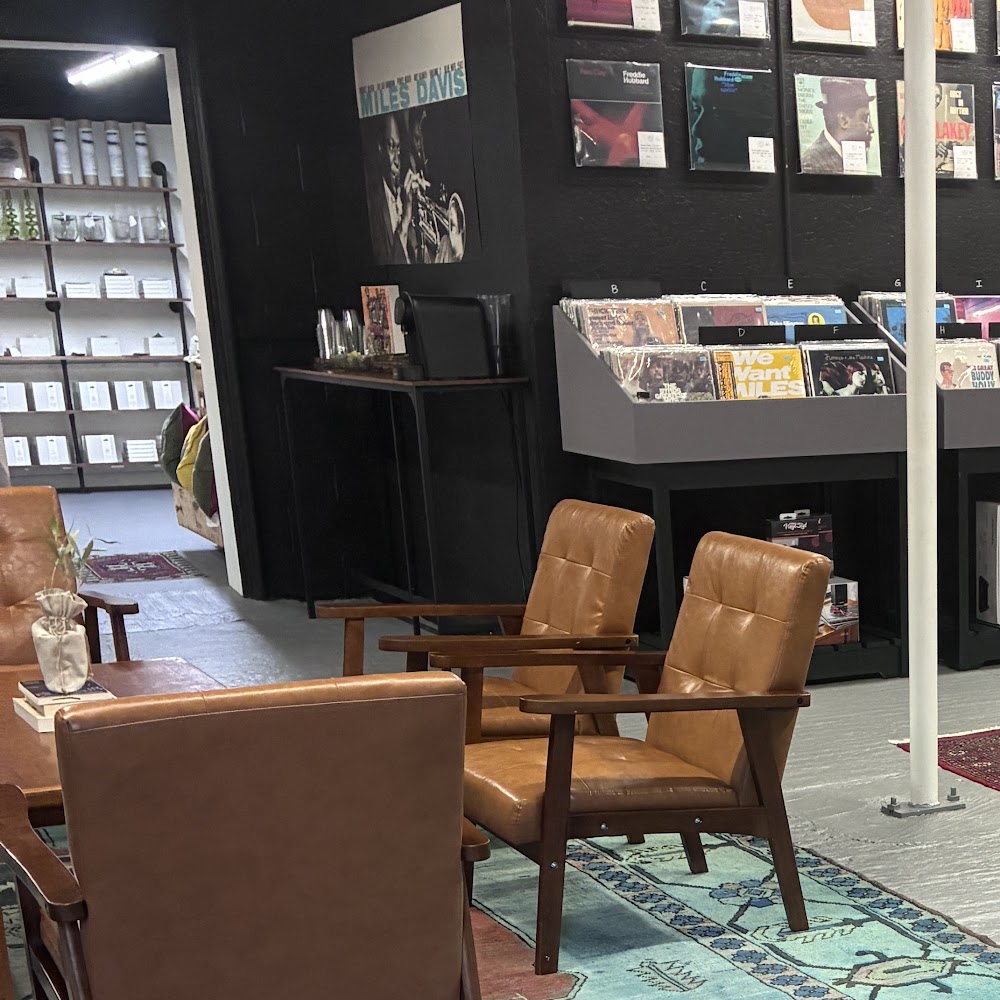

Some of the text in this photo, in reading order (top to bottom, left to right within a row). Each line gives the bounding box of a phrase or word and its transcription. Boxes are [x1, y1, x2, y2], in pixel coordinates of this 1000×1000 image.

[622, 70, 646, 79] Freddie
[360, 80, 410, 117] MILES
[417, 66, 466, 106] DAVIS
[935, 121, 972, 141] LAKEY
[700, 281, 707, 291] C
[787, 279, 794, 289] E
[894, 278, 902, 287] G
[975, 279, 983, 288] I
[611, 284, 619, 294] B
[737, 327, 746, 337] D
[832, 325, 840, 334] F
[939, 325, 946, 335] H
[733, 350, 775, 365] We
[970, 371, 994, 380] BUDDY
